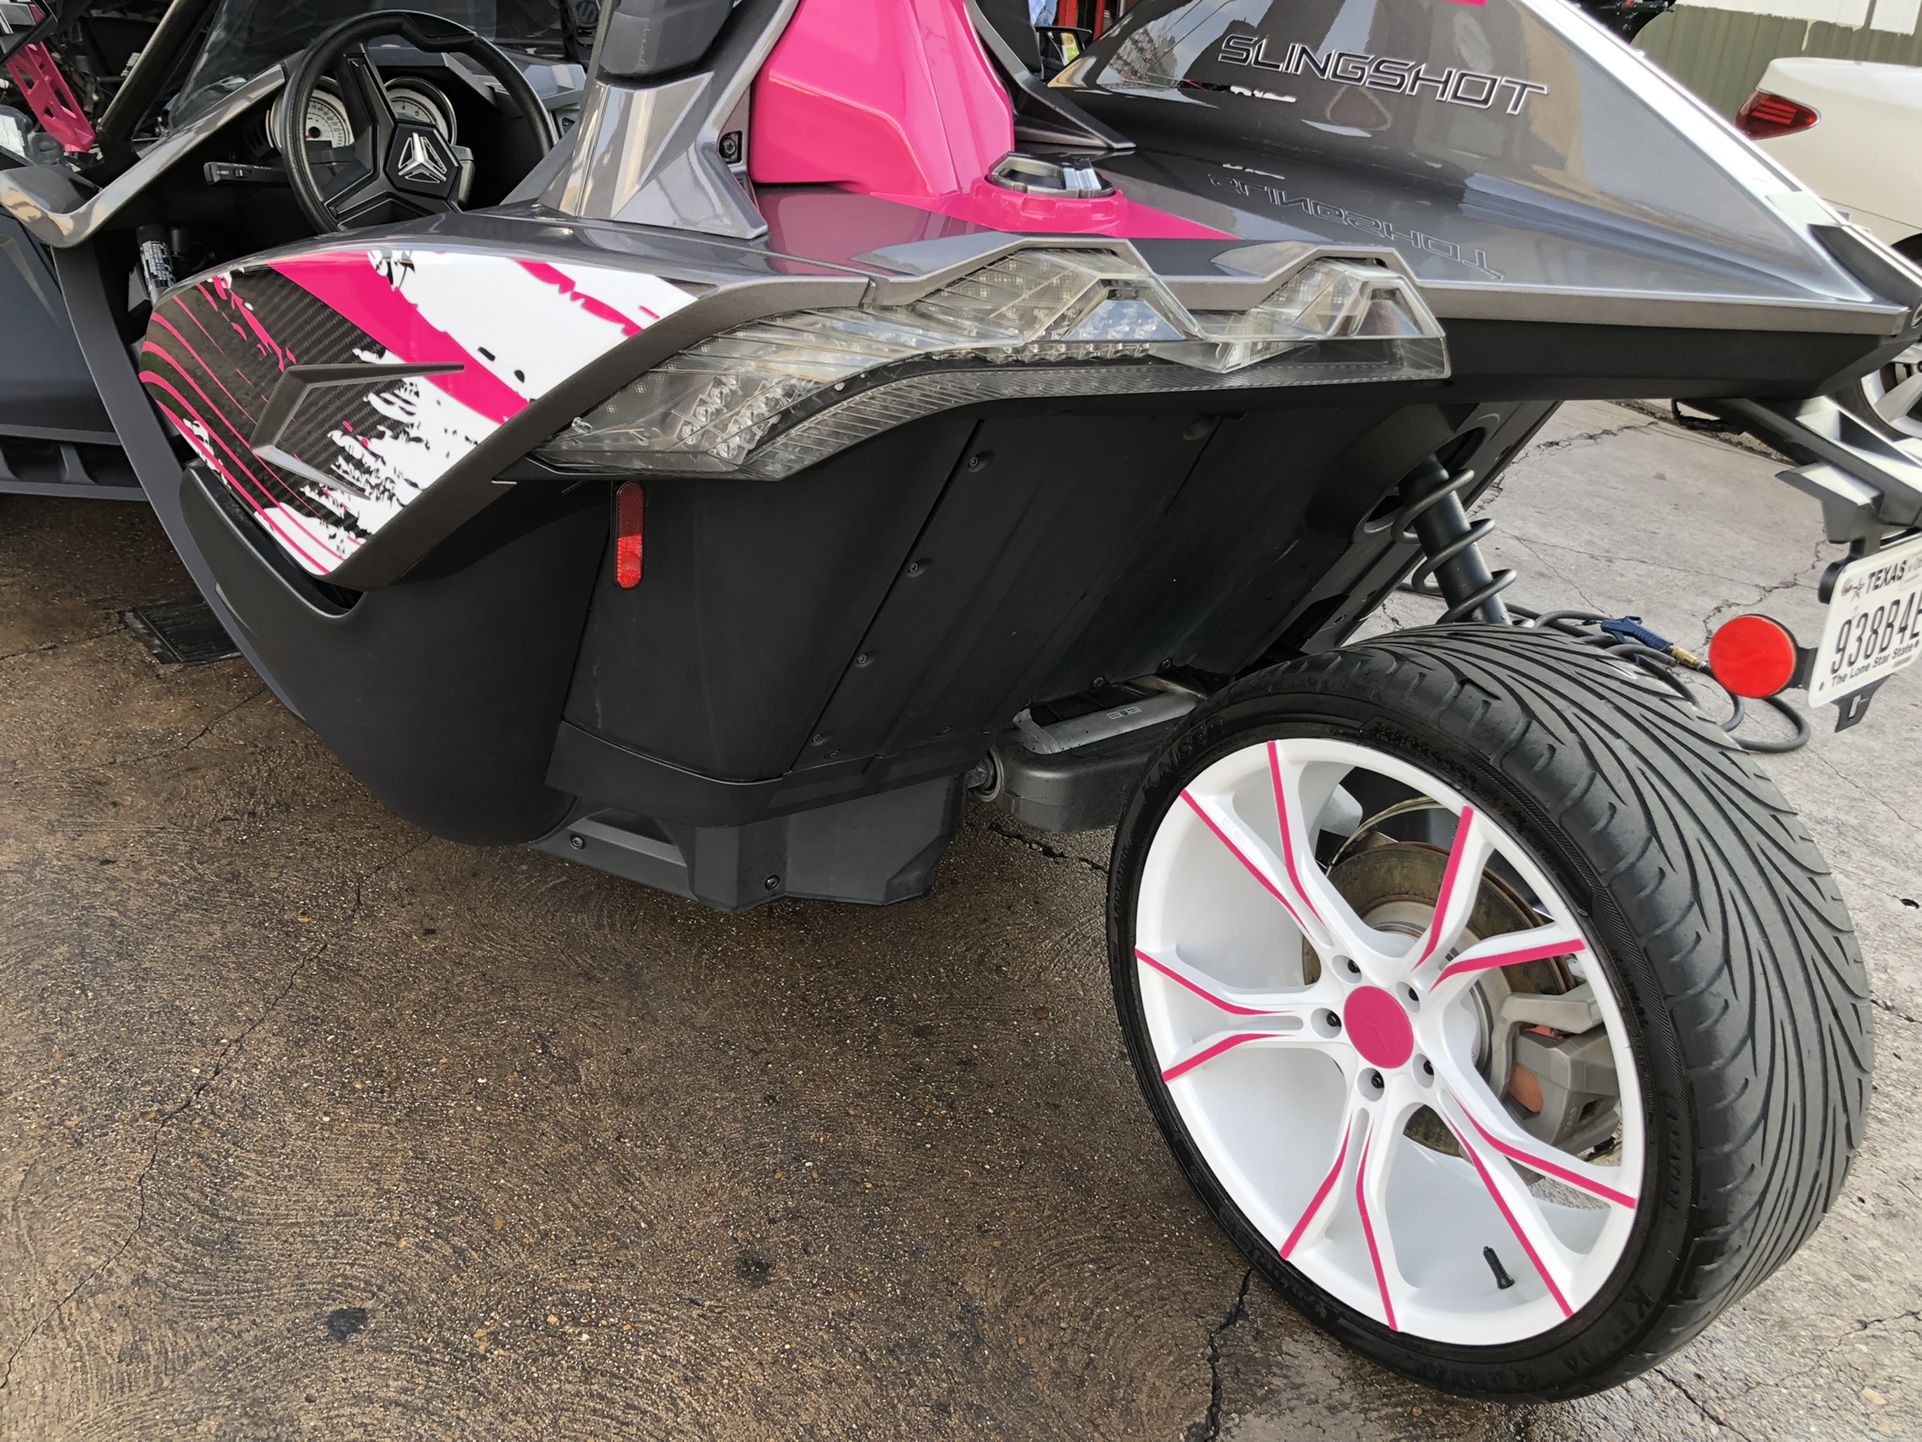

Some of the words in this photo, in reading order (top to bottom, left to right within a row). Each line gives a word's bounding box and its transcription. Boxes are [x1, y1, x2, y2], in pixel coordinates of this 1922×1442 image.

[1217, 32, 1549, 116] SLINGSHOT
[1866, 559, 1907, 594] TEXAS
[1831, 674, 1848, 688] The
[1850, 663, 1871, 679] Lone
[1872, 654, 1891, 669] Star
[1892, 643, 1914, 659] State
